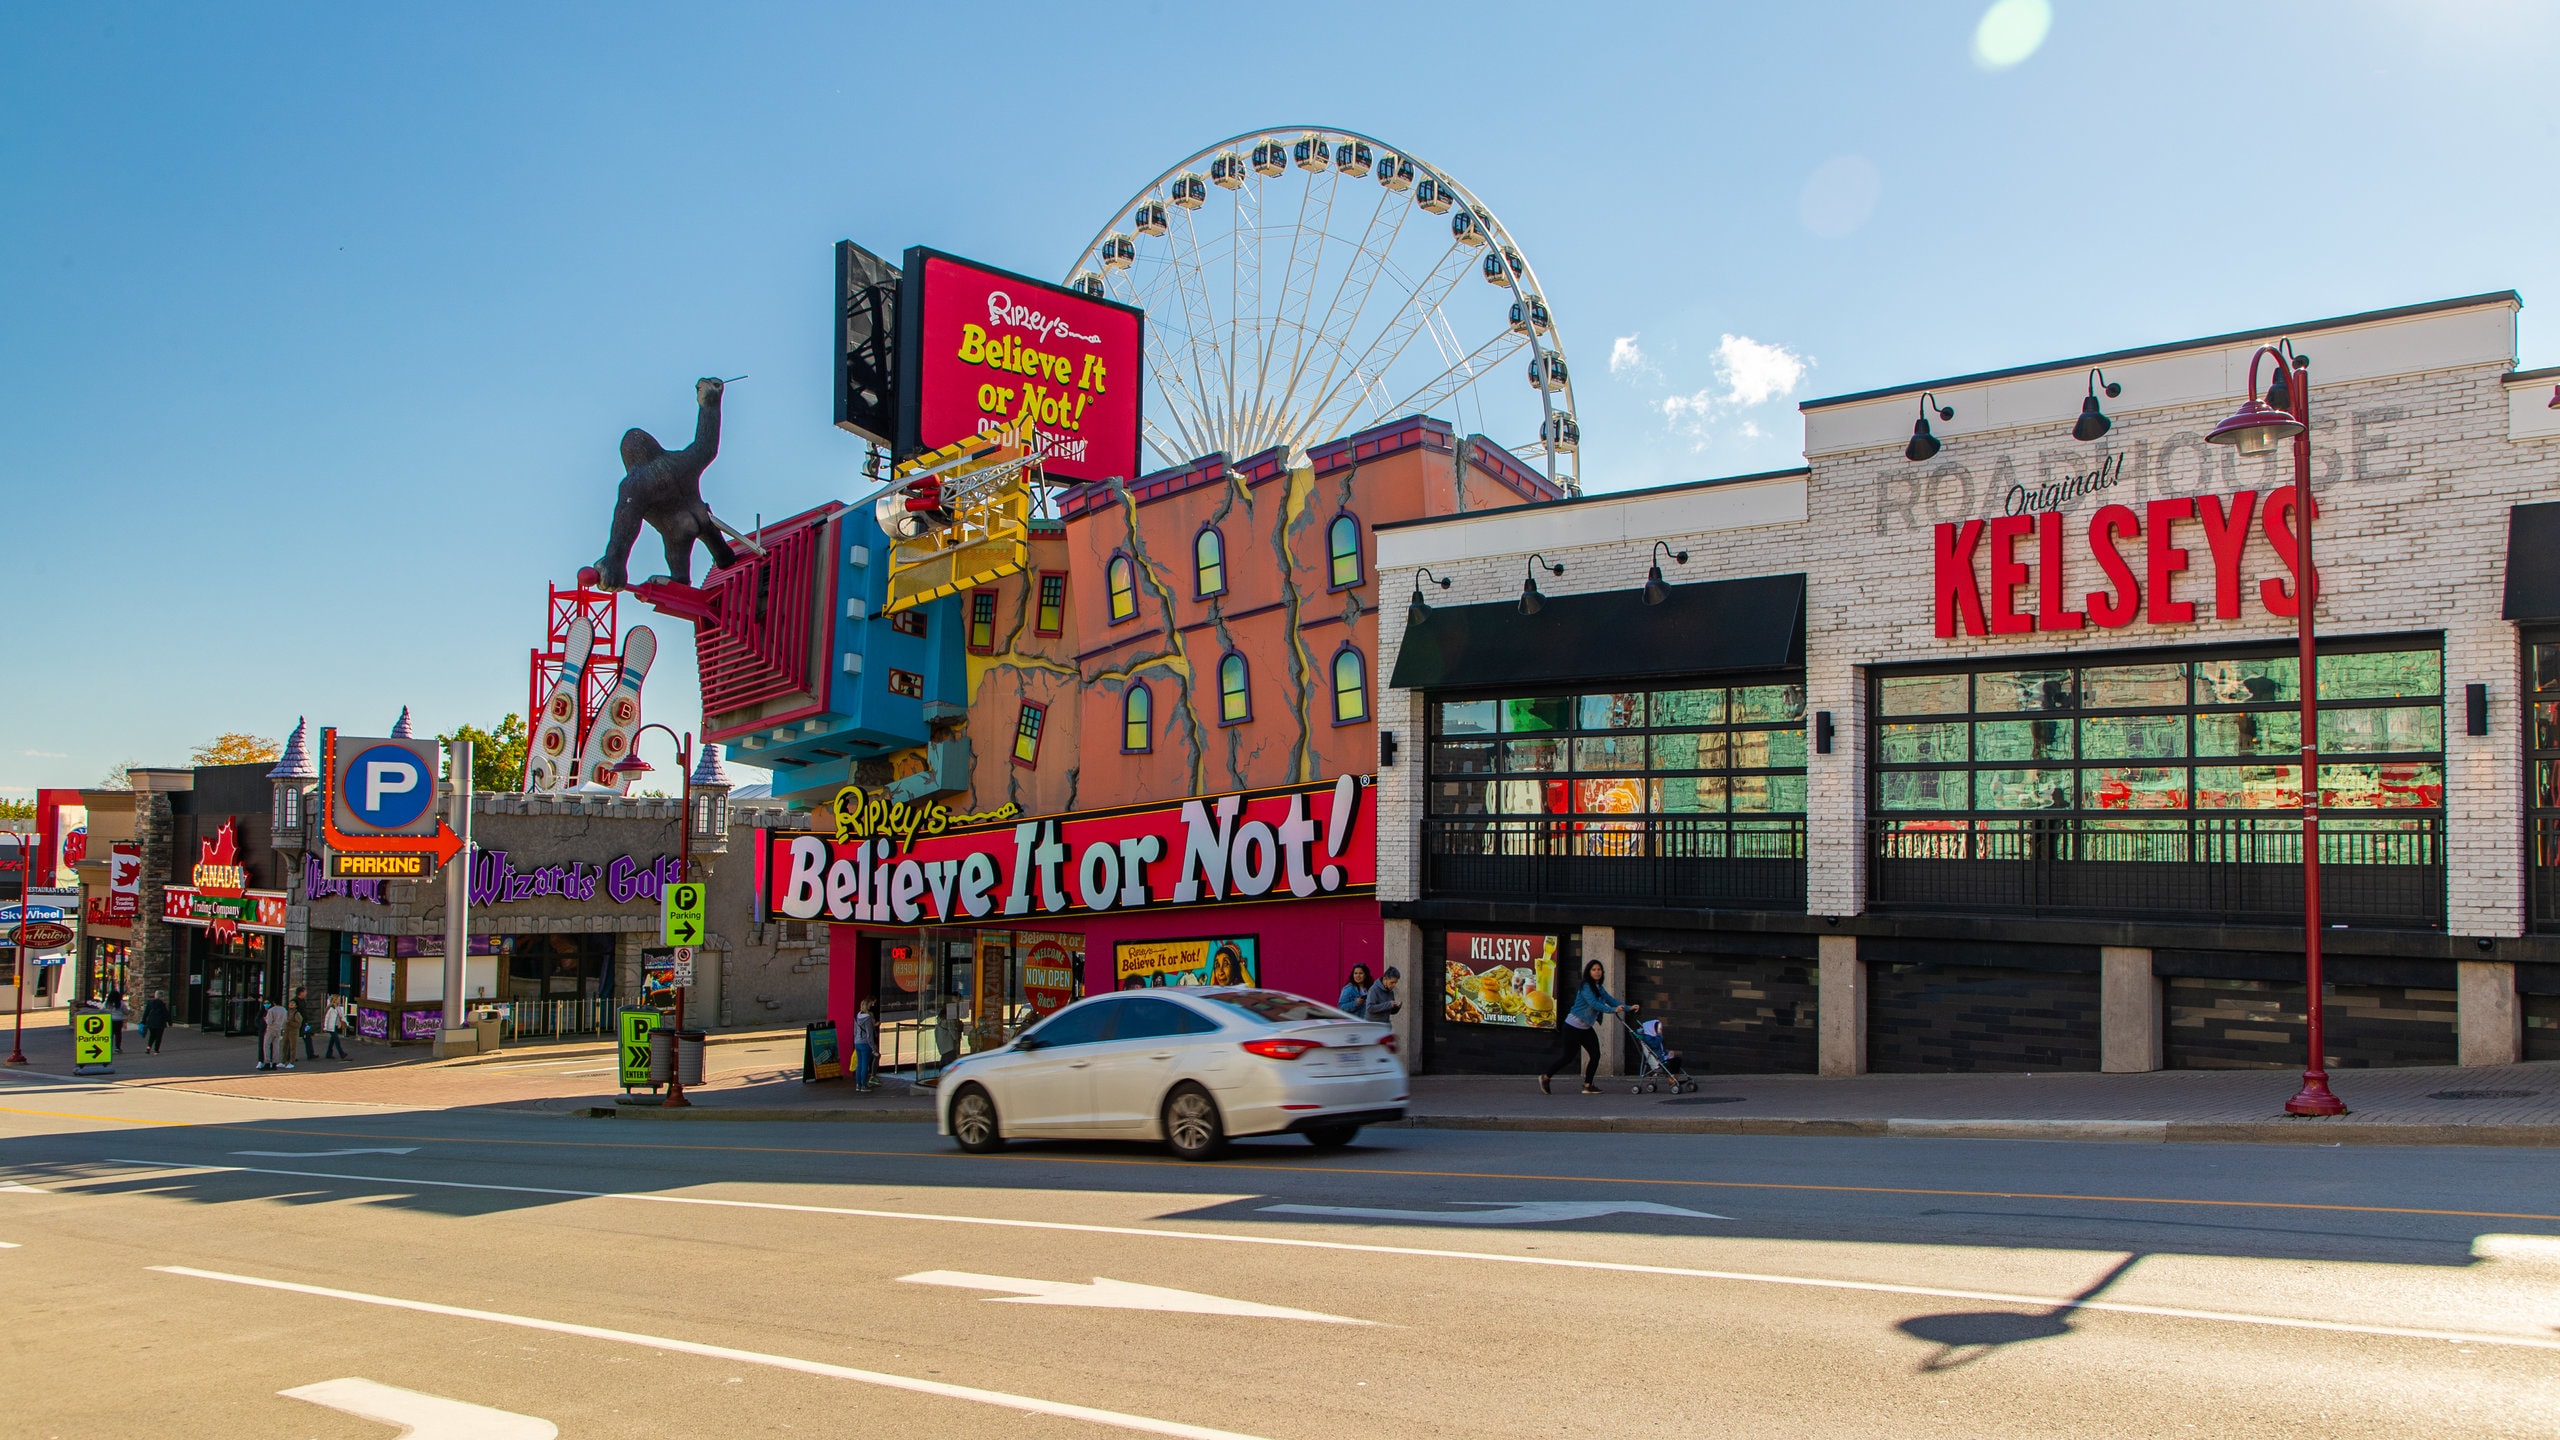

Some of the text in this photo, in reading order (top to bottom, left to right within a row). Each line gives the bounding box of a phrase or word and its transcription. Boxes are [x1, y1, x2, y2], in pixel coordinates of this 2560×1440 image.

[958, 324, 1107, 394] Believe It
[978, 383, 1086, 431] or Not!
[2004, 453, 2124, 519] Original!
[1935, 485, 2320, 638] KELSEYS
[366, 761, 418, 811] P
[782, 774, 1354, 923] Believe It or Not!
[192, 863, 241, 889] CANADA
[340, 857, 420, 873] PARKING
[608, 854, 691, 904] Golf
[194, 900, 240, 918] Trading Company
[670, 911, 701, 920] Parking
[1058, 933, 1067, 946] It
[1069, 936, 1080, 946] or
[1471, 937, 1531, 962] KELSEYS
[1033, 947, 1065, 965] WELCOME
[1122, 948, 1200, 972] Believe It or Not!
[1026, 968, 1071, 988] NOW OPEN
[1484, 1013, 1516, 1023] LIVE MUSIC
[78, 1035, 110, 1043] Parking
[634, 1019, 648, 1041] P
[626, 1071, 644, 1079] ENTER
